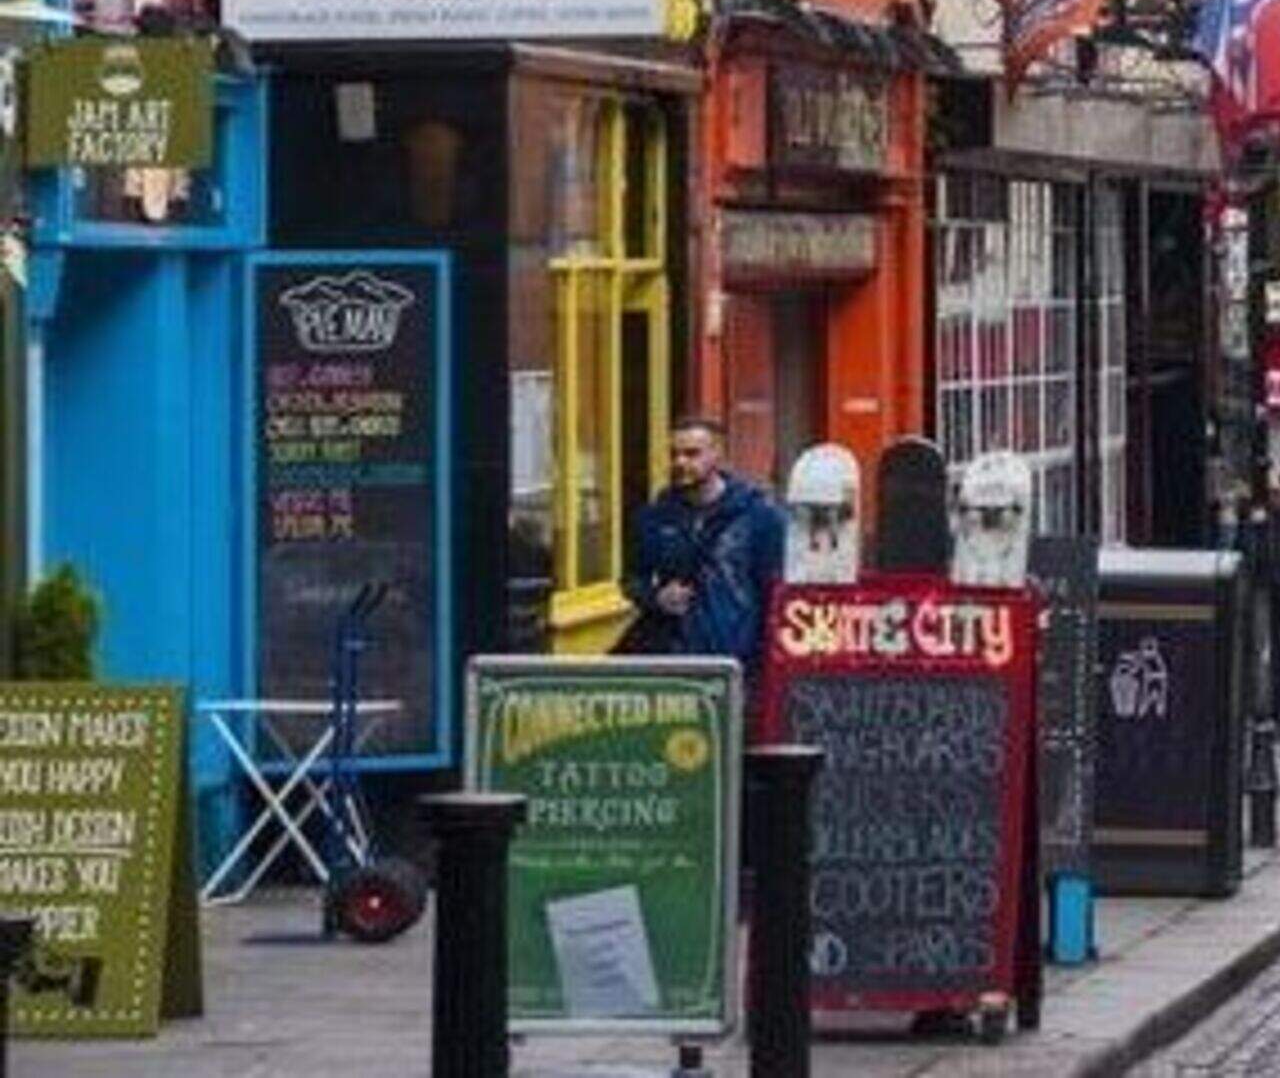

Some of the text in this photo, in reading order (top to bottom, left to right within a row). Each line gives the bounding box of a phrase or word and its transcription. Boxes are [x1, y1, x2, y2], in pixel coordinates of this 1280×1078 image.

[124, 98, 171, 129] ART
[67, 129, 167, 164] FACTORY
[780, 590, 1014, 668] SKATE CITY
[66, 710, 149, 748] MAKES
[503, 691, 650, 765] CONNECTED
[48, 757, 125, 795] HAPPY
[537, 761, 670, 792] TATTOO
[51, 809, 137, 845] DESIGN
[527, 795, 682, 830] PIERCING
[76, 855, 120, 895] YOU
[810, 867, 1002, 922] COOTERS
